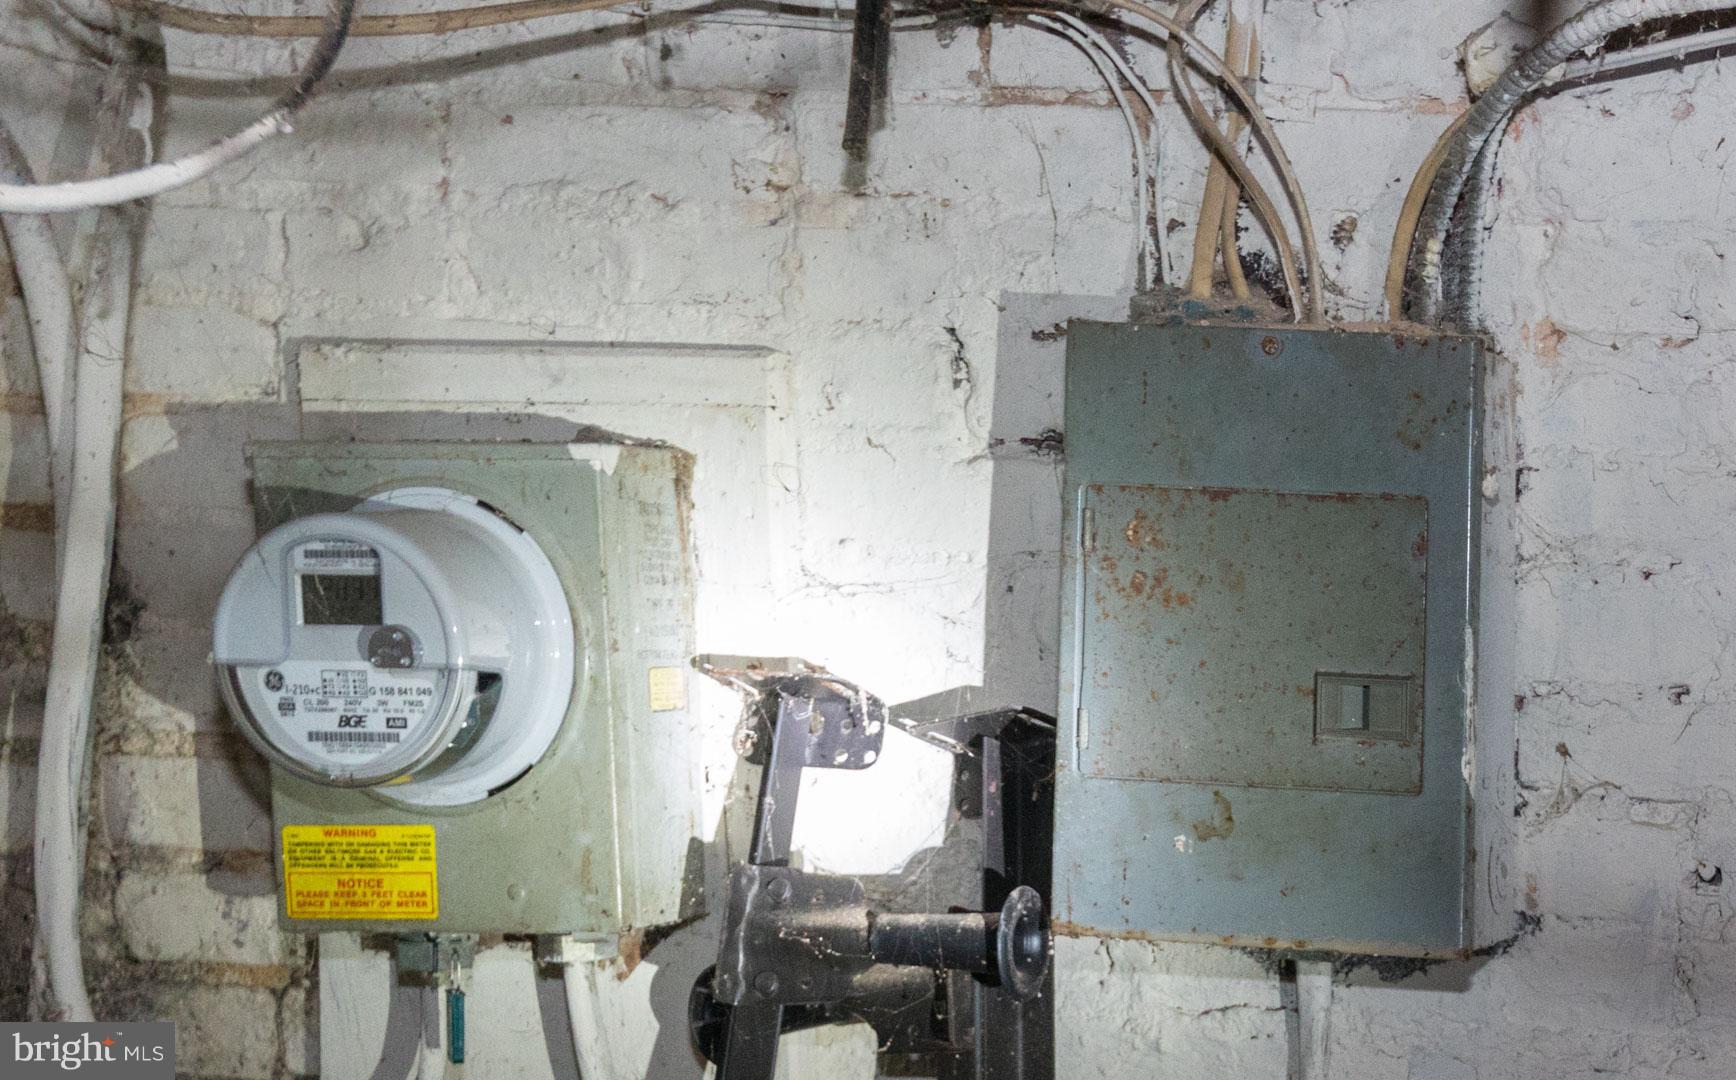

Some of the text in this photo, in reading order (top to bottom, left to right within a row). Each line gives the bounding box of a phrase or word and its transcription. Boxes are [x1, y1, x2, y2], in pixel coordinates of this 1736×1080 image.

[380, 686, 395, 696] 158
[397, 686, 413, 696] 841
[416, 687, 433, 697] 049
[338, 715, 368, 728] BGE
[323, 828, 377, 838] WARNING
[336, 878, 384, 889] NOTICE
[296, 890, 329, 898] PLEASE
[335, 890, 357, 898] KEEP
[296, 900, 428, 908] SPACE IN FRONT OF METER
